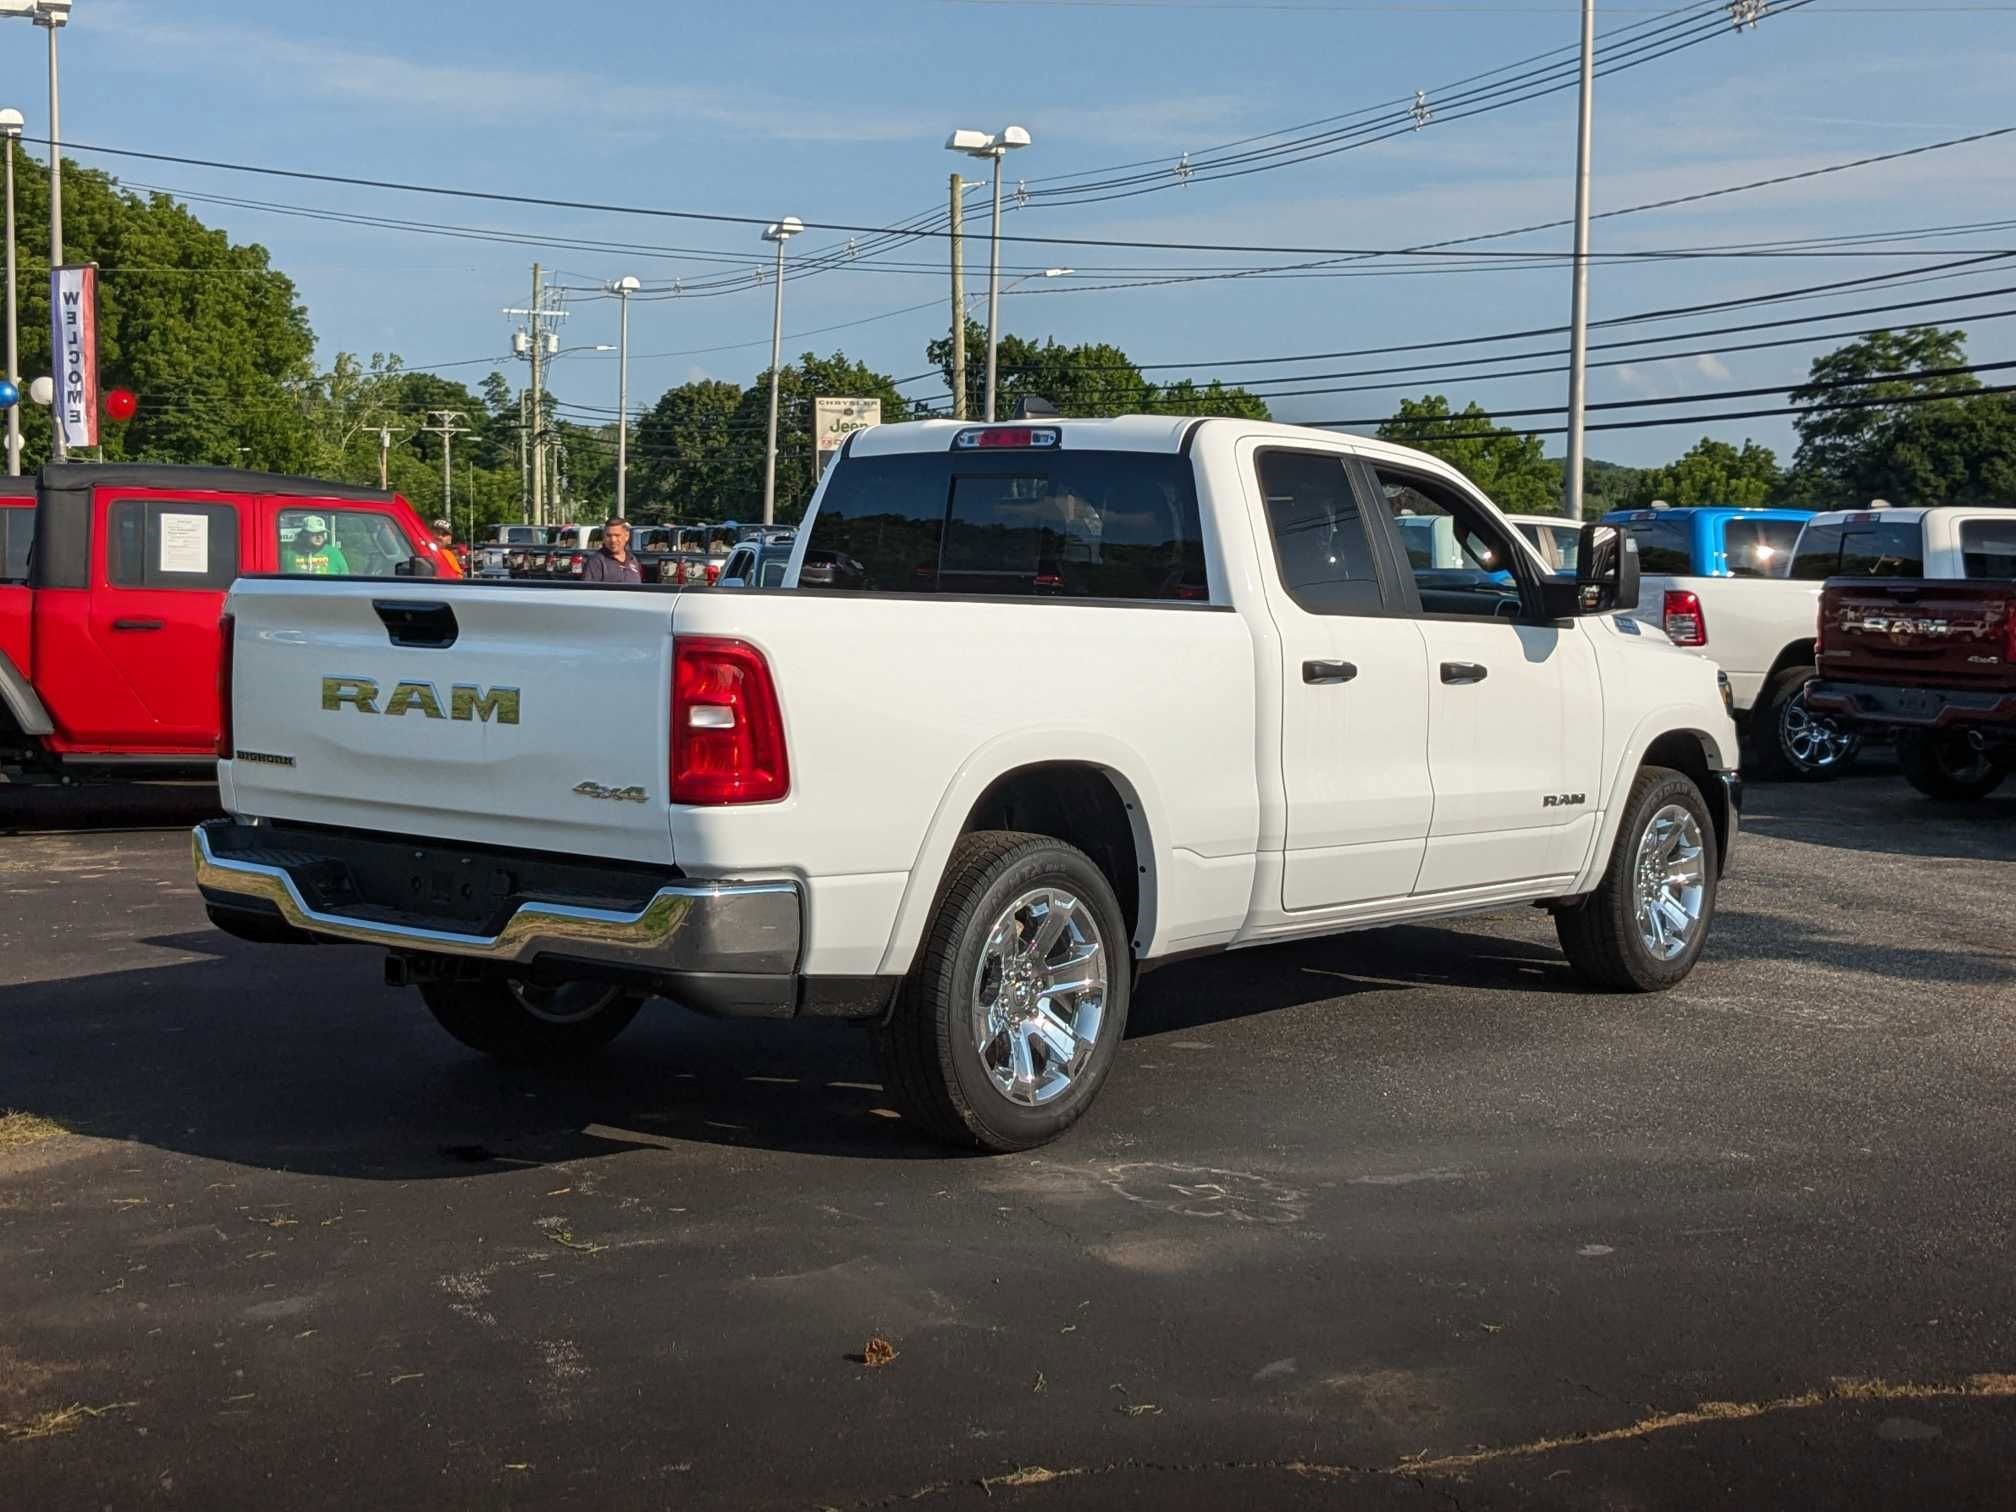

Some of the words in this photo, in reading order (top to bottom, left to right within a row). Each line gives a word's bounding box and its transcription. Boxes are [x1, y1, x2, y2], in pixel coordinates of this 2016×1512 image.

[321, 673, 520, 725] RAM
[572, 781, 649, 804] 4x4
[1543, 793, 1585, 808] RAM
